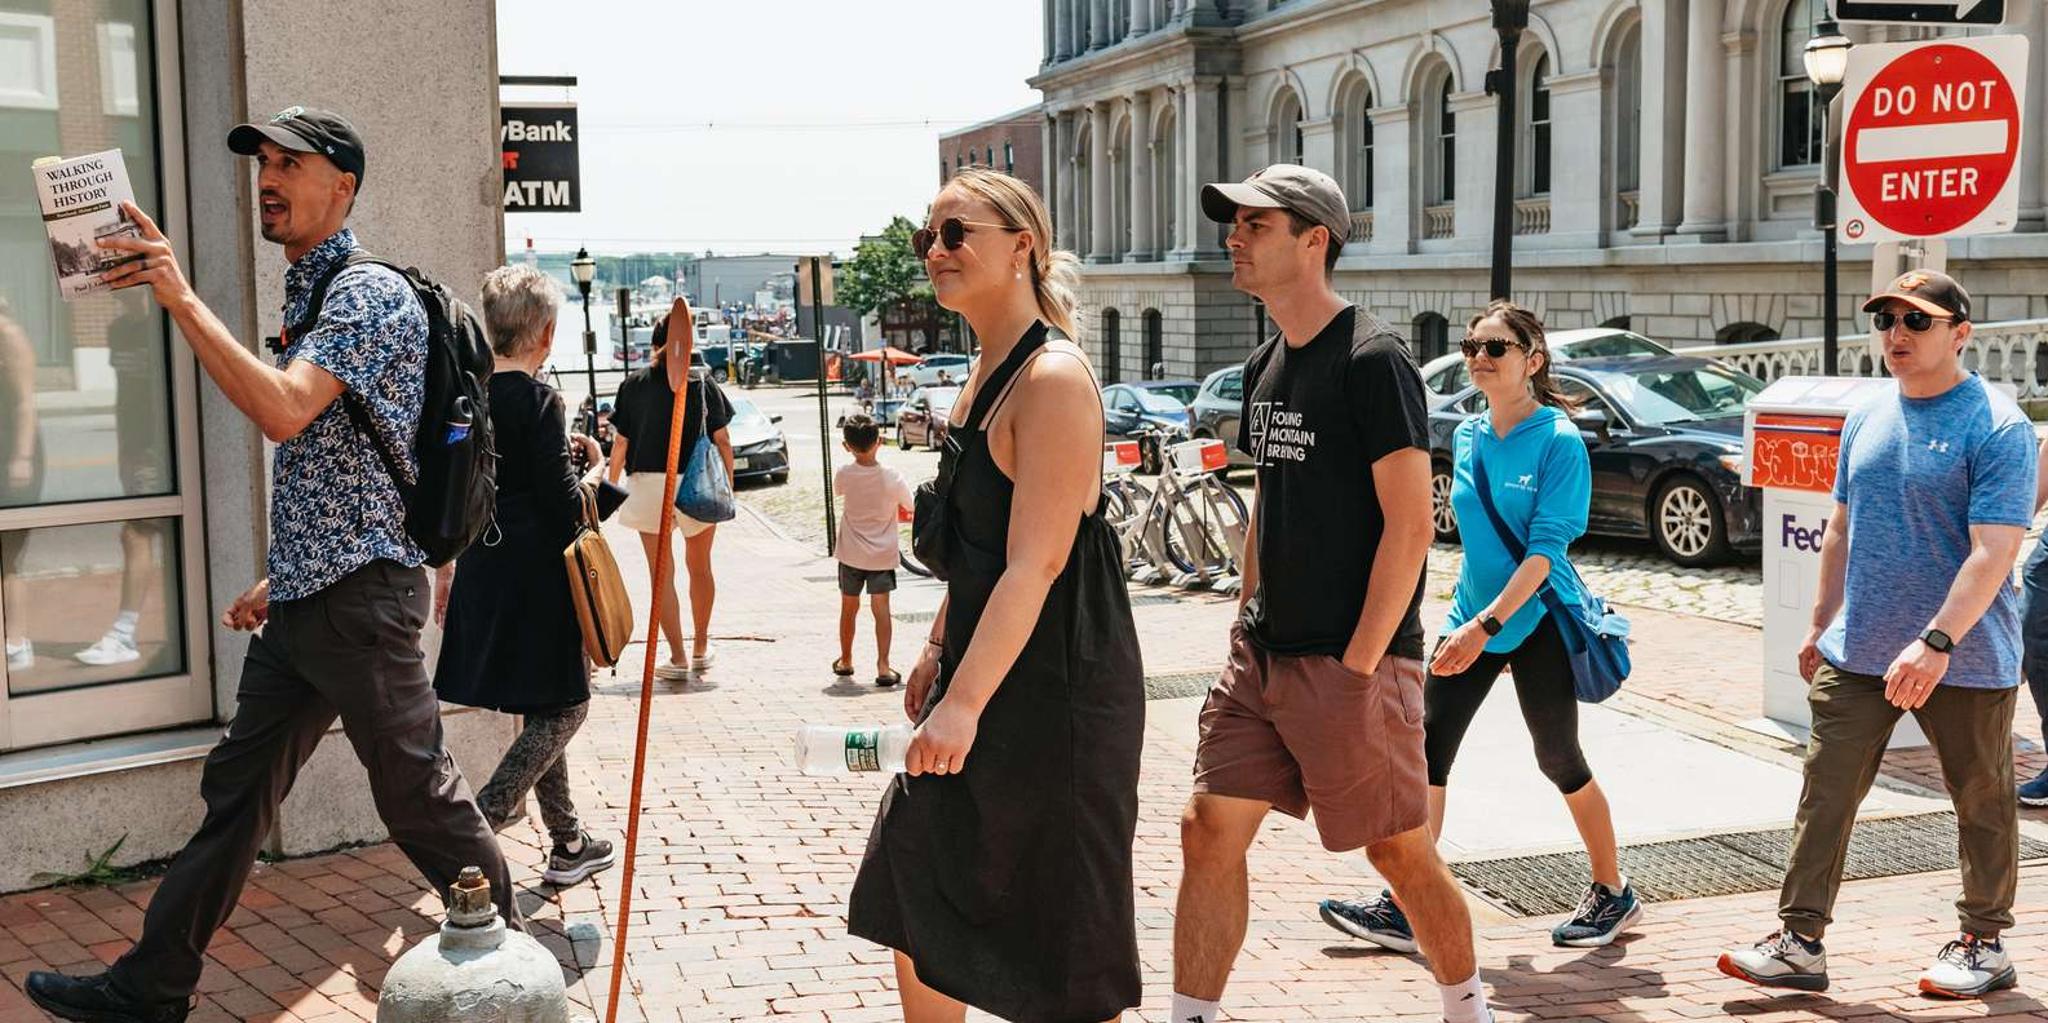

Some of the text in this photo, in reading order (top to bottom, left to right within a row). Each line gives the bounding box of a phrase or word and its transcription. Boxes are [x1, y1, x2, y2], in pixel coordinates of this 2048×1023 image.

[1873, 80, 1997, 117] DO NOT
[46, 159, 104, 181] WALKING
[50, 171, 114, 195] THROUGH
[504, 181, 570, 206] ATM
[1881, 167, 1979, 202] ENTER
[54, 187, 108, 208] HISTORY
[1268, 427, 1315, 447] MONTAIN
